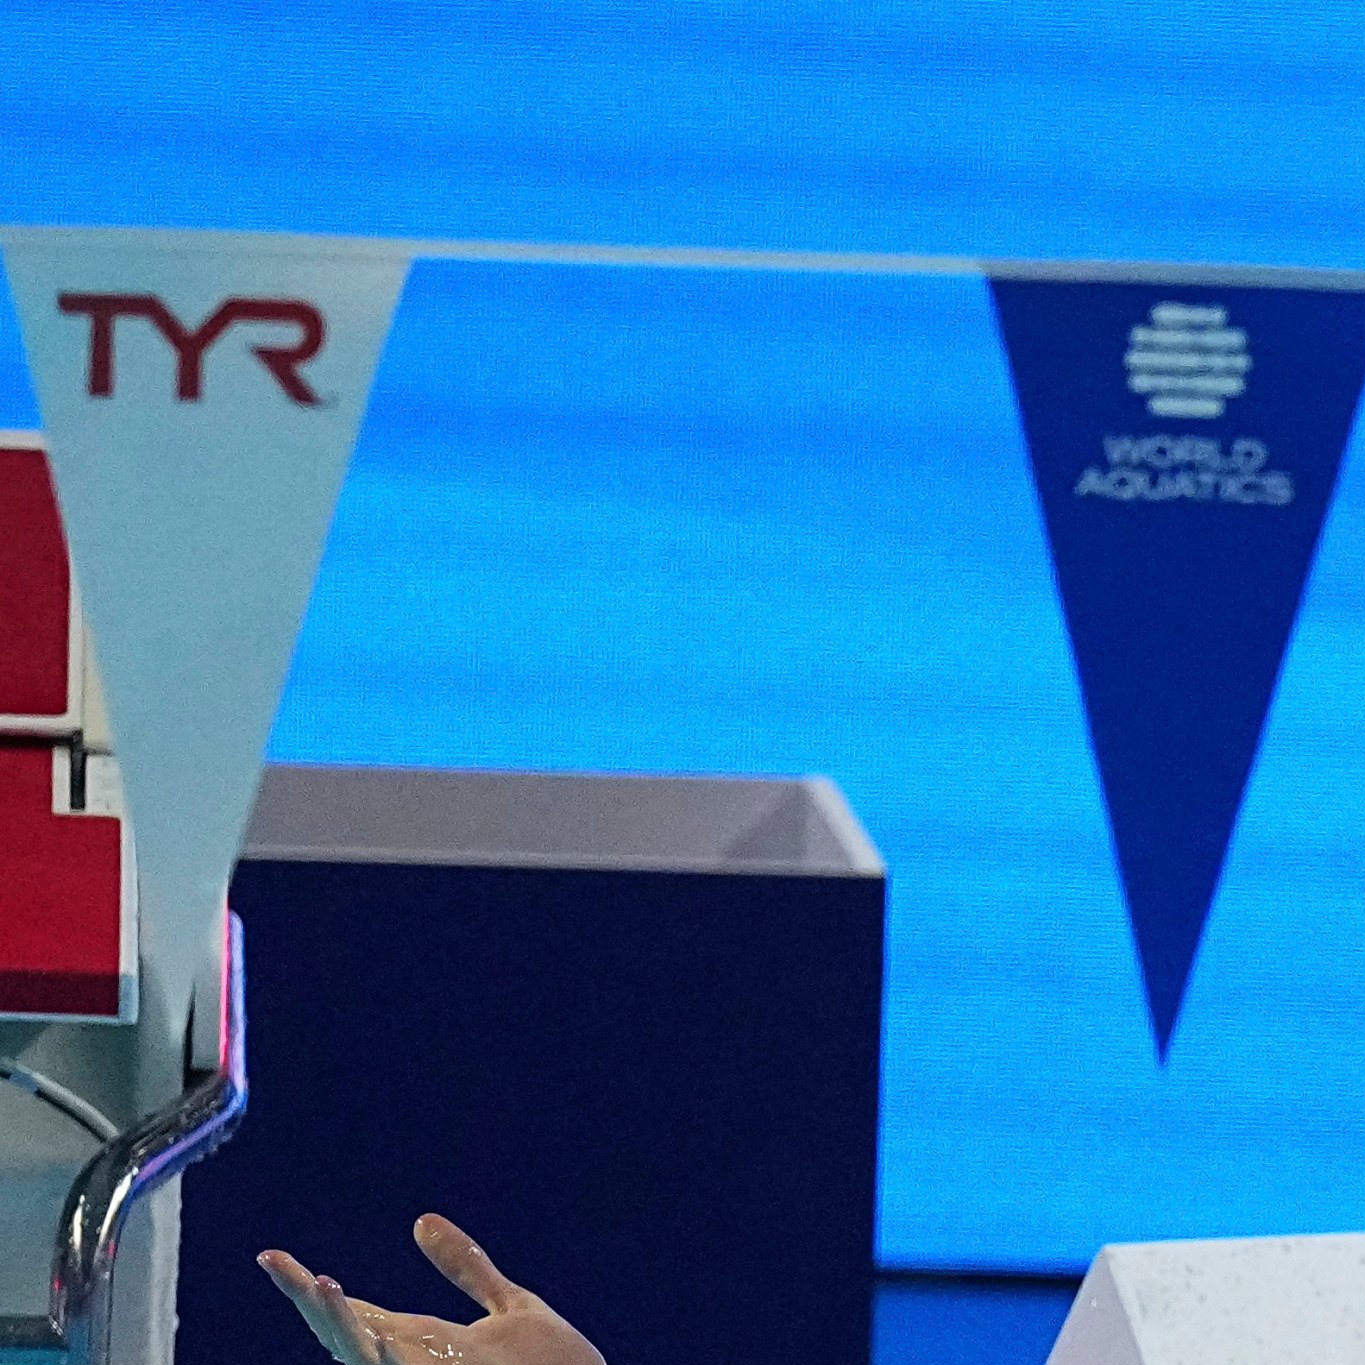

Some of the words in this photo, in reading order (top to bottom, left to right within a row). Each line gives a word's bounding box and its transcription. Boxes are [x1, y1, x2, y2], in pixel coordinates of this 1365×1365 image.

[57, 290, 330, 407] TYR
[1102, 434, 1270, 470] WORLD
[1073, 466, 1295, 505] AQUATICS
